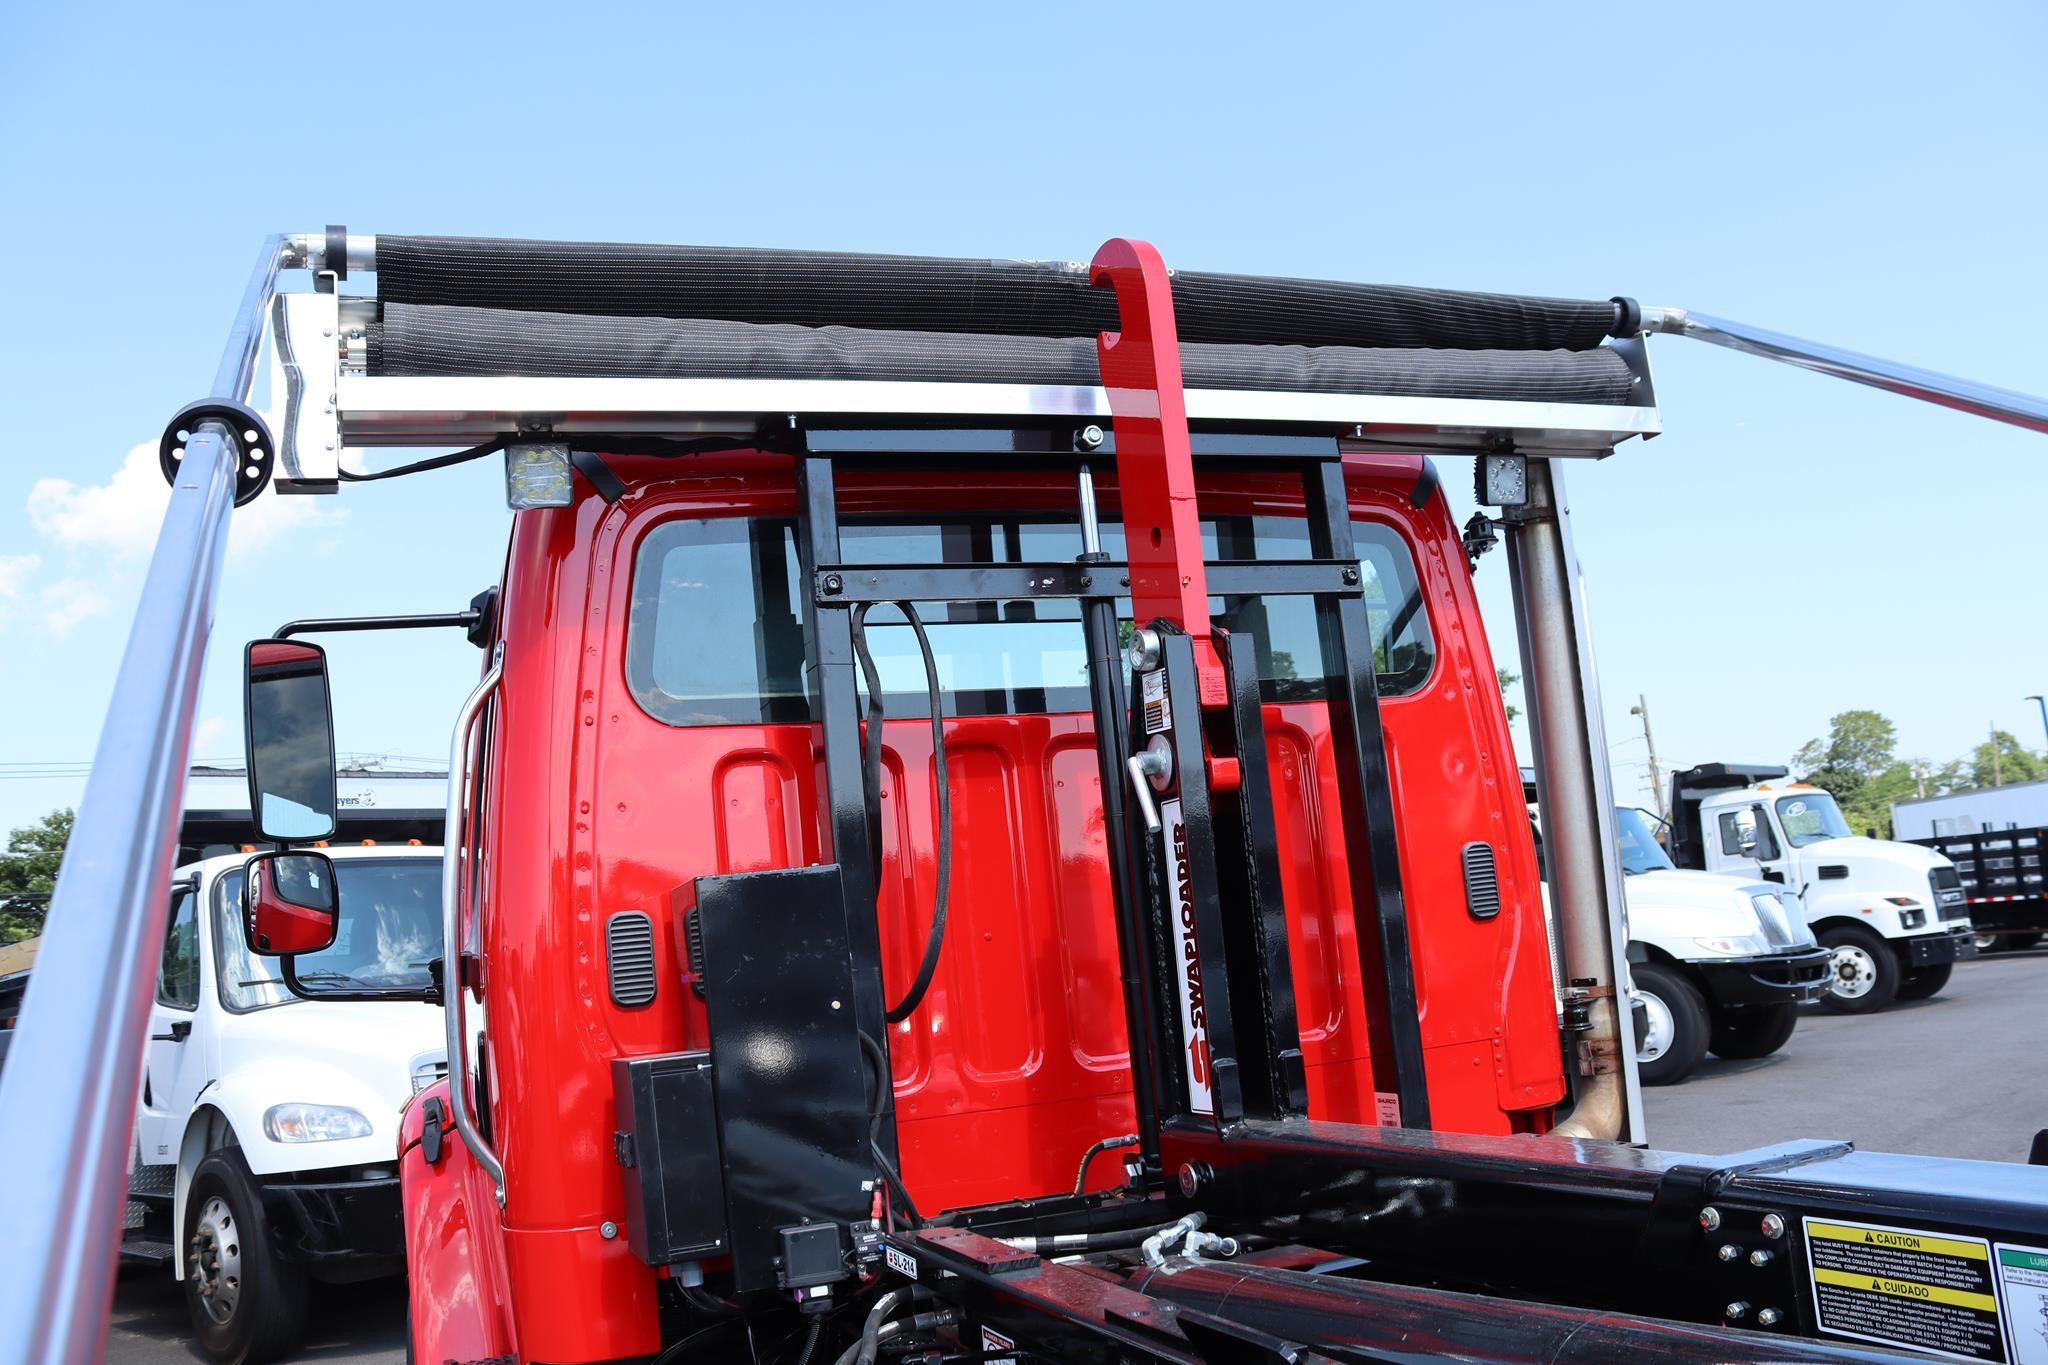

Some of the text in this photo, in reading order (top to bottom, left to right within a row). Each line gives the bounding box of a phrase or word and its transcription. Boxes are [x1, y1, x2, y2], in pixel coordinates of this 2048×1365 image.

[1173, 822, 1204, 1029] SWAPLOADER
[1876, 1234, 1920, 1248] CAUTION
[894, 1253, 915, 1274] SL-214
[1884, 1281, 1929, 1298] CUIDADO
